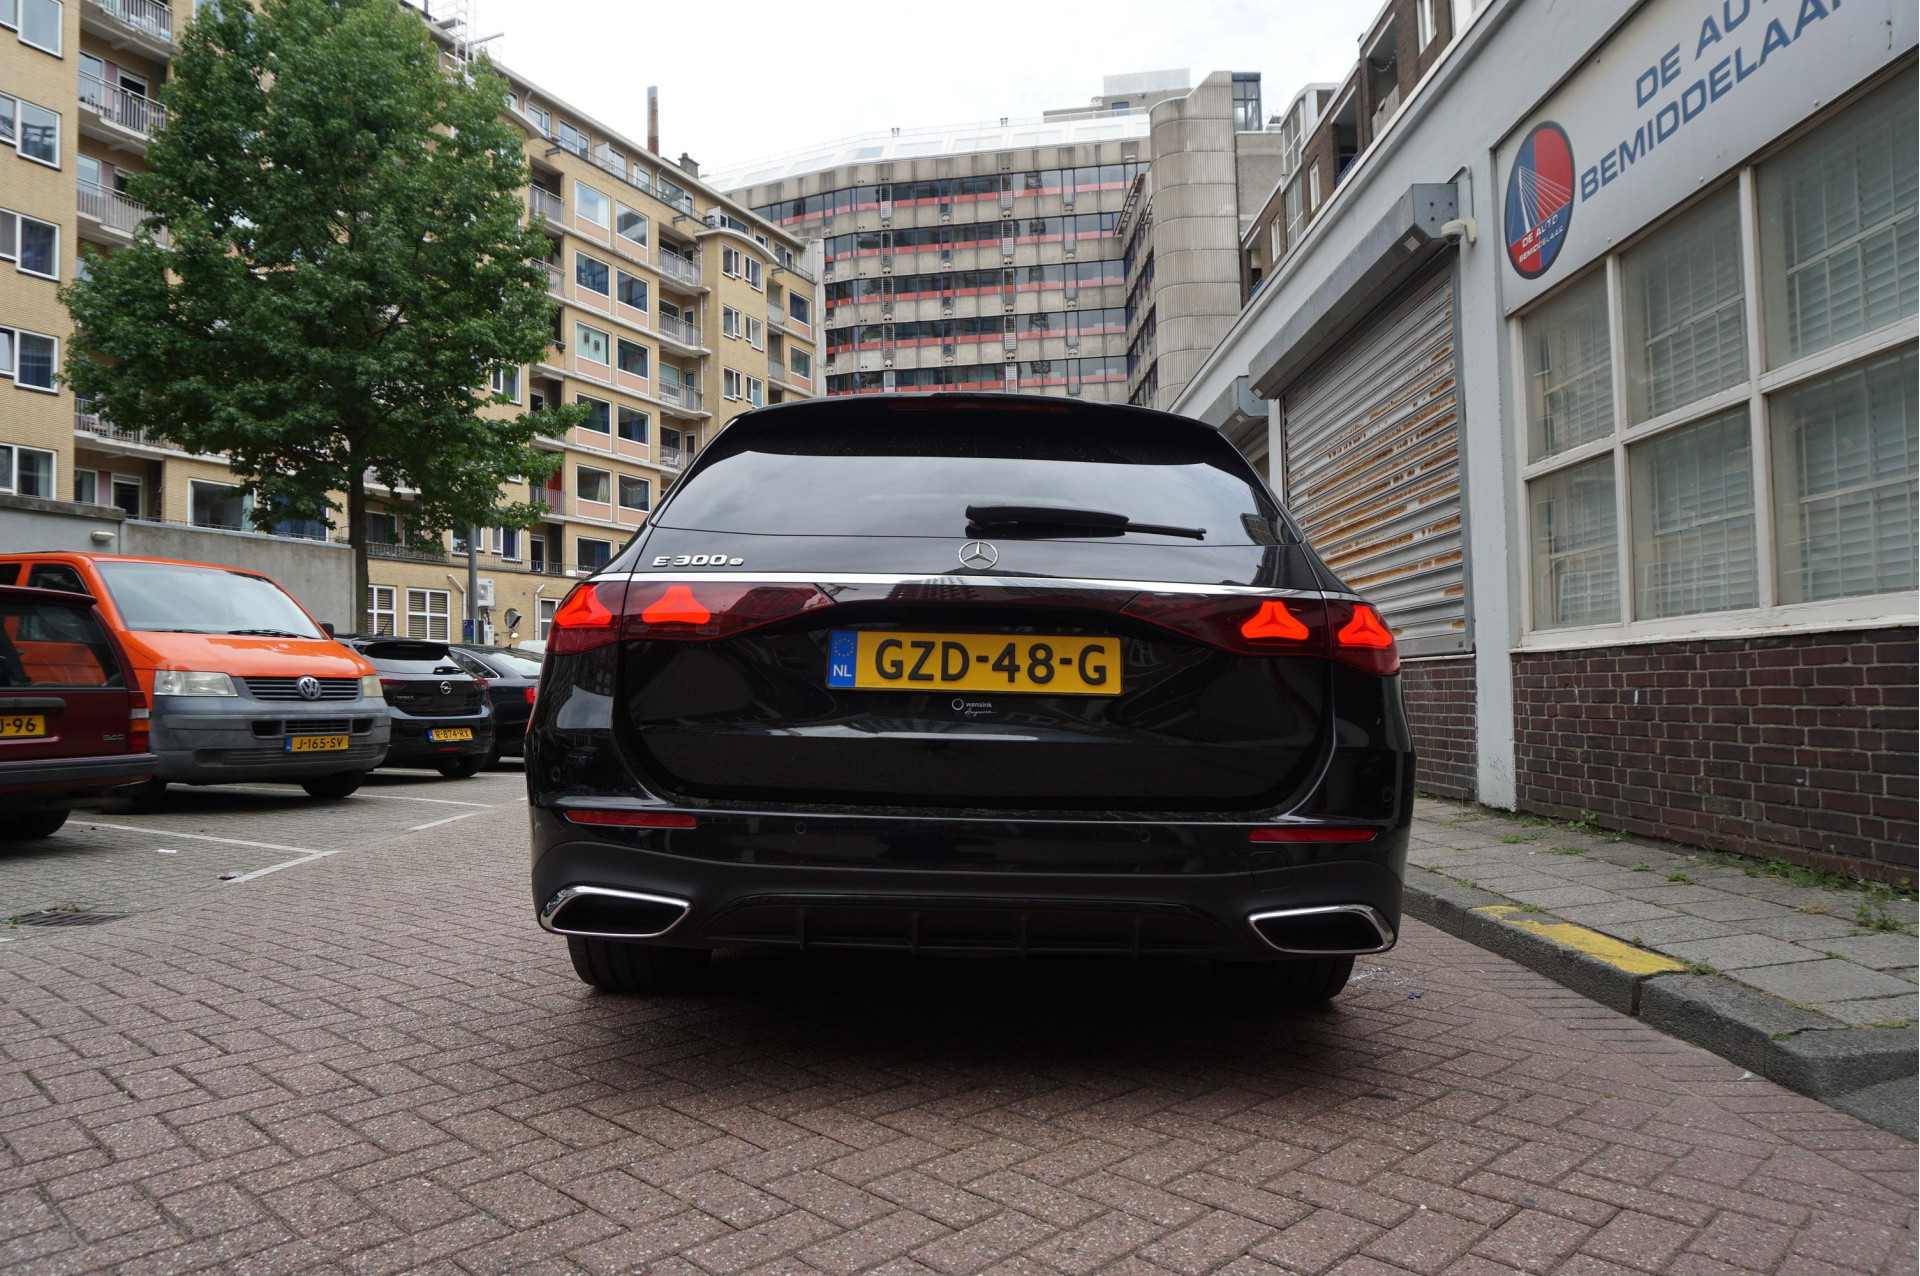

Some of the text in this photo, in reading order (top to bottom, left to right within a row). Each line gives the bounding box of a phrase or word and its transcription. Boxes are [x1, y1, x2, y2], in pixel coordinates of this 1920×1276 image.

[1636, 0, 1769, 109] DE AU
[1580, 0, 1842, 203] BEMIDDELAA
[1522, 214, 1559, 248] DE AUTO
[832, 664, 852, 677] NL
[875, 638, 1108, 685] GZD-48-G
[297, 737, 343, 750] J-165-SV
[435, 728, 470, 739] R-874-RX
